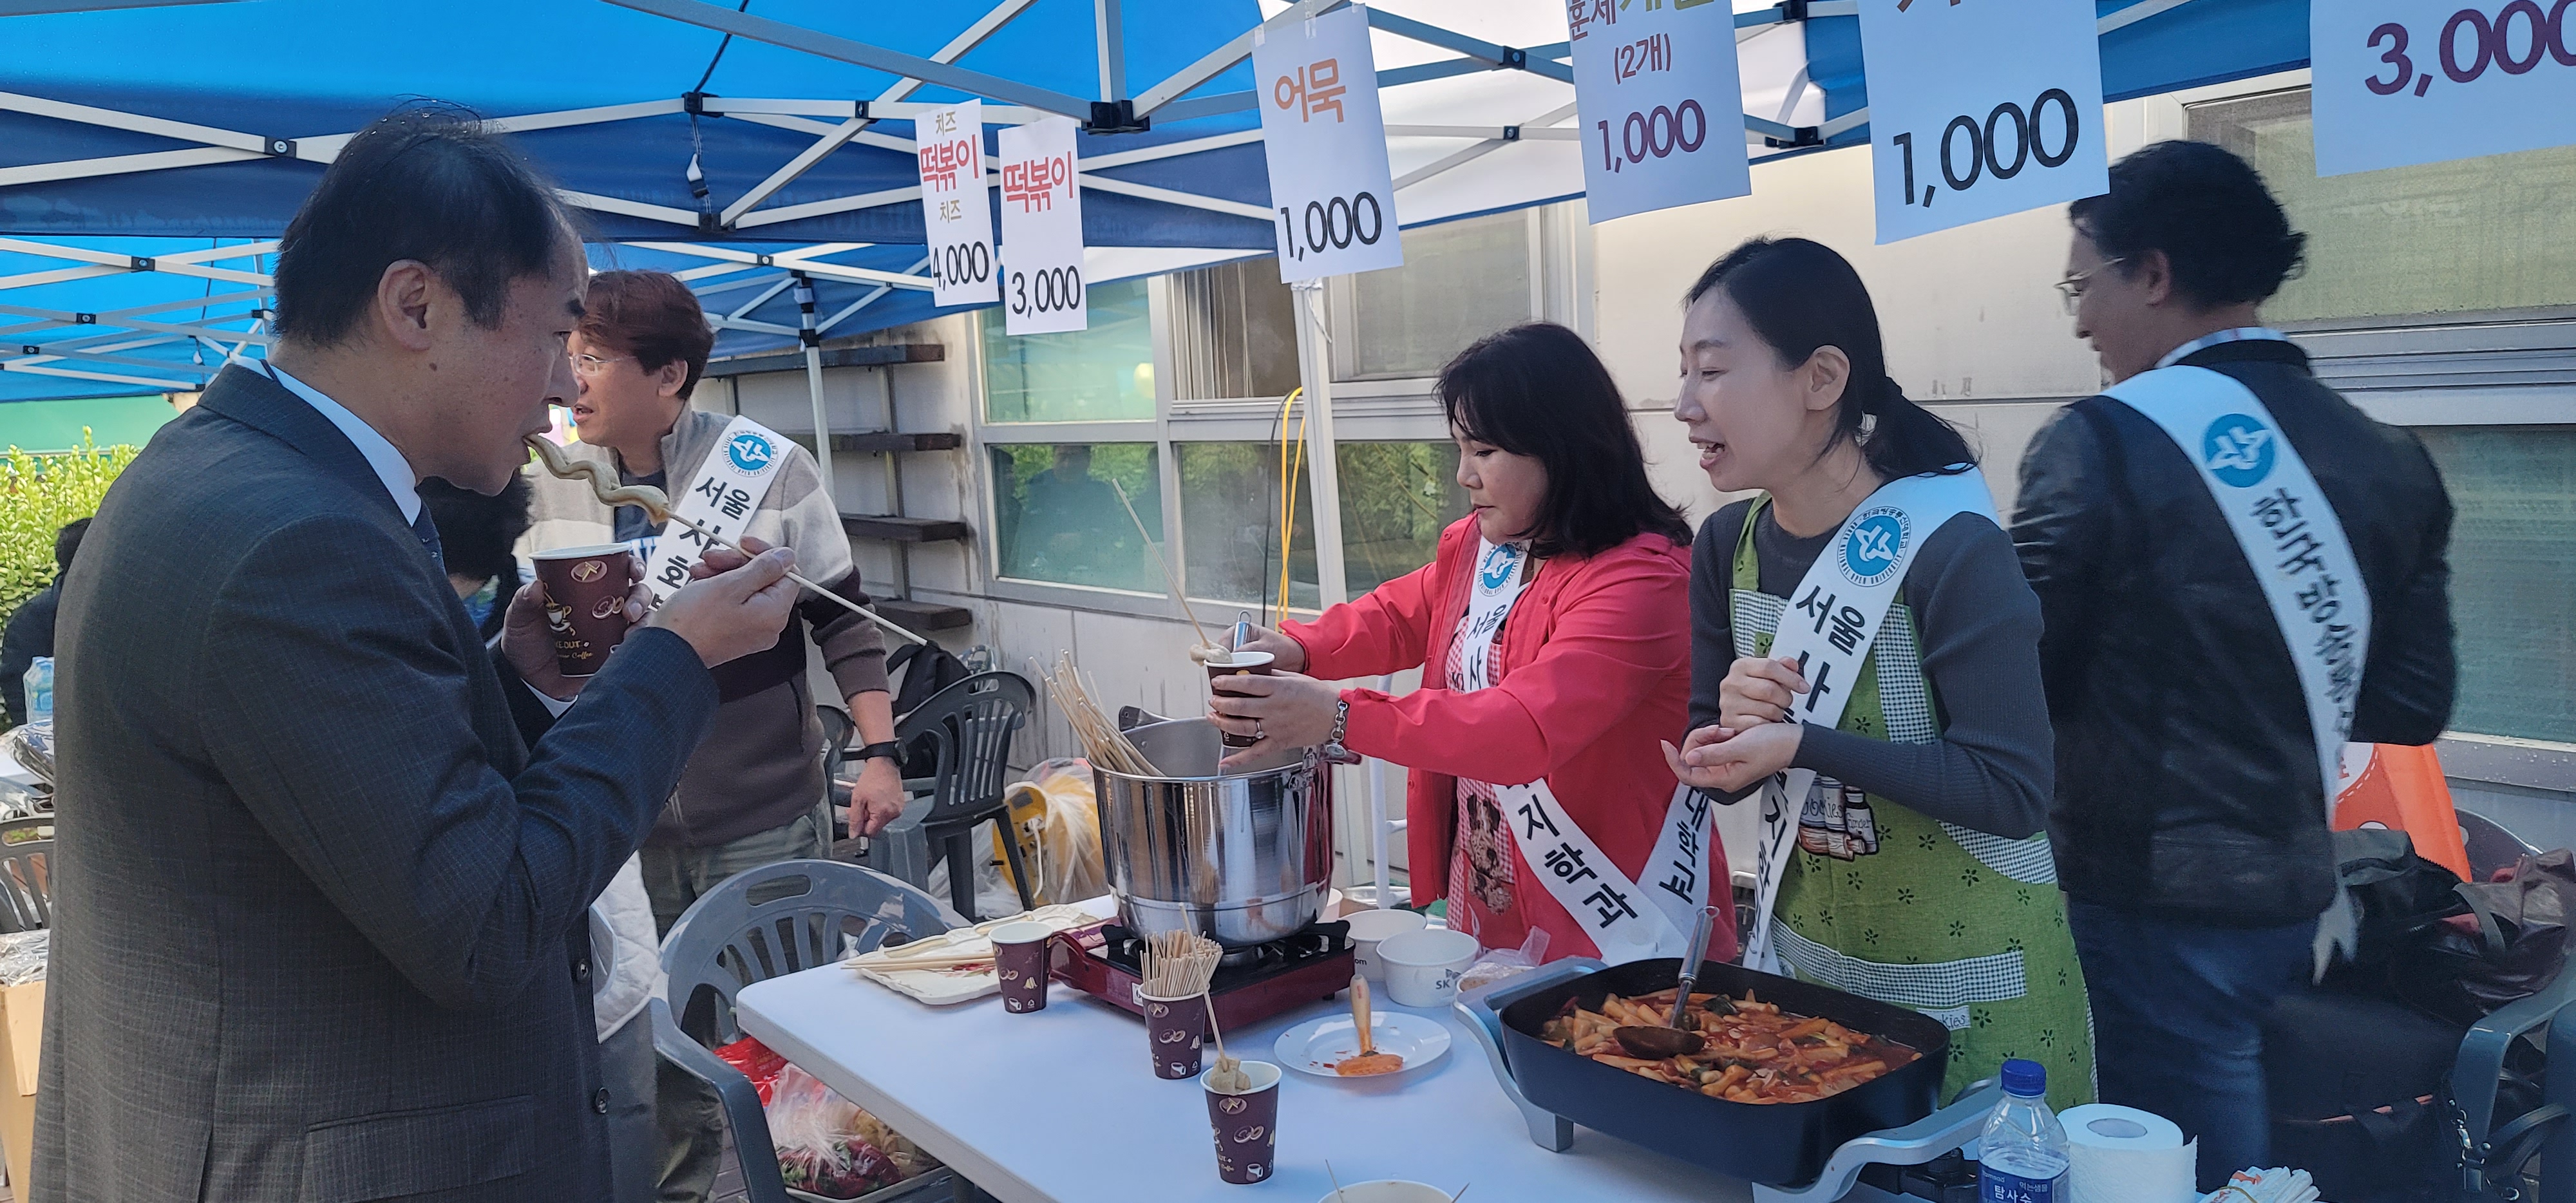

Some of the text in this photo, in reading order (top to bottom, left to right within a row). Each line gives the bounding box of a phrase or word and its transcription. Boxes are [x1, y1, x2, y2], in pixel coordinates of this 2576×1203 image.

[1614, 33, 1671, 85] (2개)
[1274, 58, 1346, 123] 어묵
[936, 111, 957, 136] 치즈
[1598, 99, 1706, 173] 1,000
[1893, 88, 2079, 208] 1,000
[920, 134, 979, 193] 떡볶이
[1003, 151, 1074, 213] 떡볶이
[940, 200, 962, 224] 치즈
[1280, 191, 1382, 262] 1,000
[933, 241, 989, 291] 4,000
[1012, 265, 1081, 319] 3,000
[696, 477, 750, 520] 서울
[1466, 604, 1507, 639] 서울
[1796, 585, 1866, 656] 서울
[1510, 784, 1638, 928] 지학과
[1435, 980, 1450, 989] SK
[1939, 1014, 1965, 1028] kies
